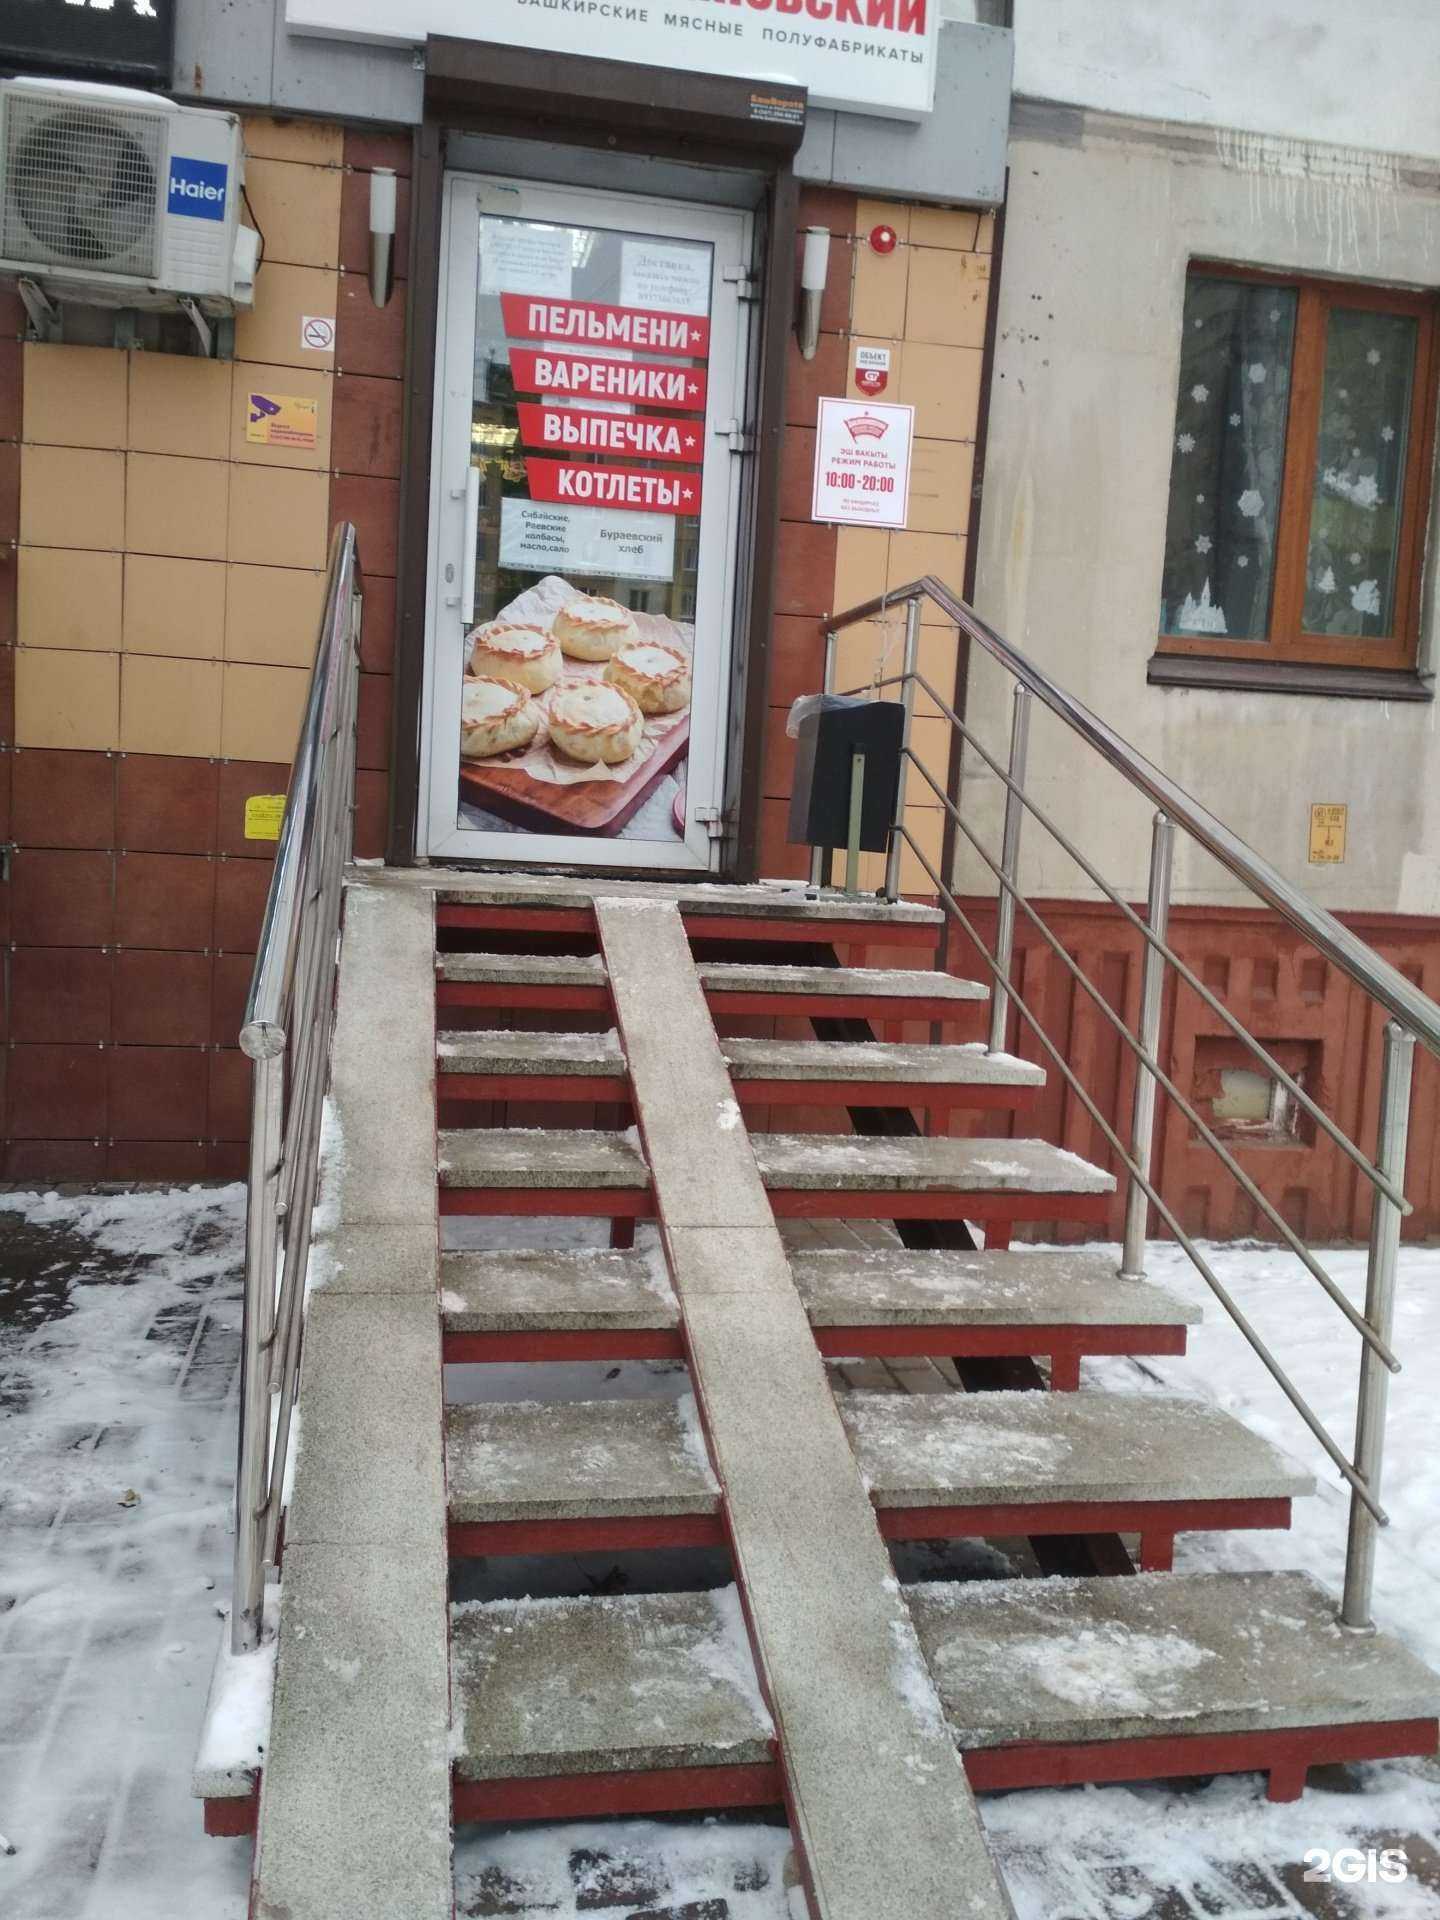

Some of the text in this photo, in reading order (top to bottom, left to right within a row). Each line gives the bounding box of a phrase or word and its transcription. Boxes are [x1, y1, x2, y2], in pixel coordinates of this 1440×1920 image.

[663, 13, 744, 36] МЯСНЫЕ
[762, 28, 924, 64] ПОЛУФАБРИКАТЫ
[170, 177, 225, 202] Haier
[528, 303, 689, 349] ПЕЛЬМЕНИ
[534, 357, 686, 401] ВАРЕНИКИ
[543, 413, 682, 454] ВЫПЕЧКА
[831, 457, 897, 469] РЕЖИМ РАБОТЫ
[558, 468, 681, 506] КОТЛЕТЫ
[525, 521, 567, 533] Раевские
[525, 533, 565, 545] колбасы,
[600, 529, 664, 544] Бураевский
[618, 544, 644, 554] хлеб
